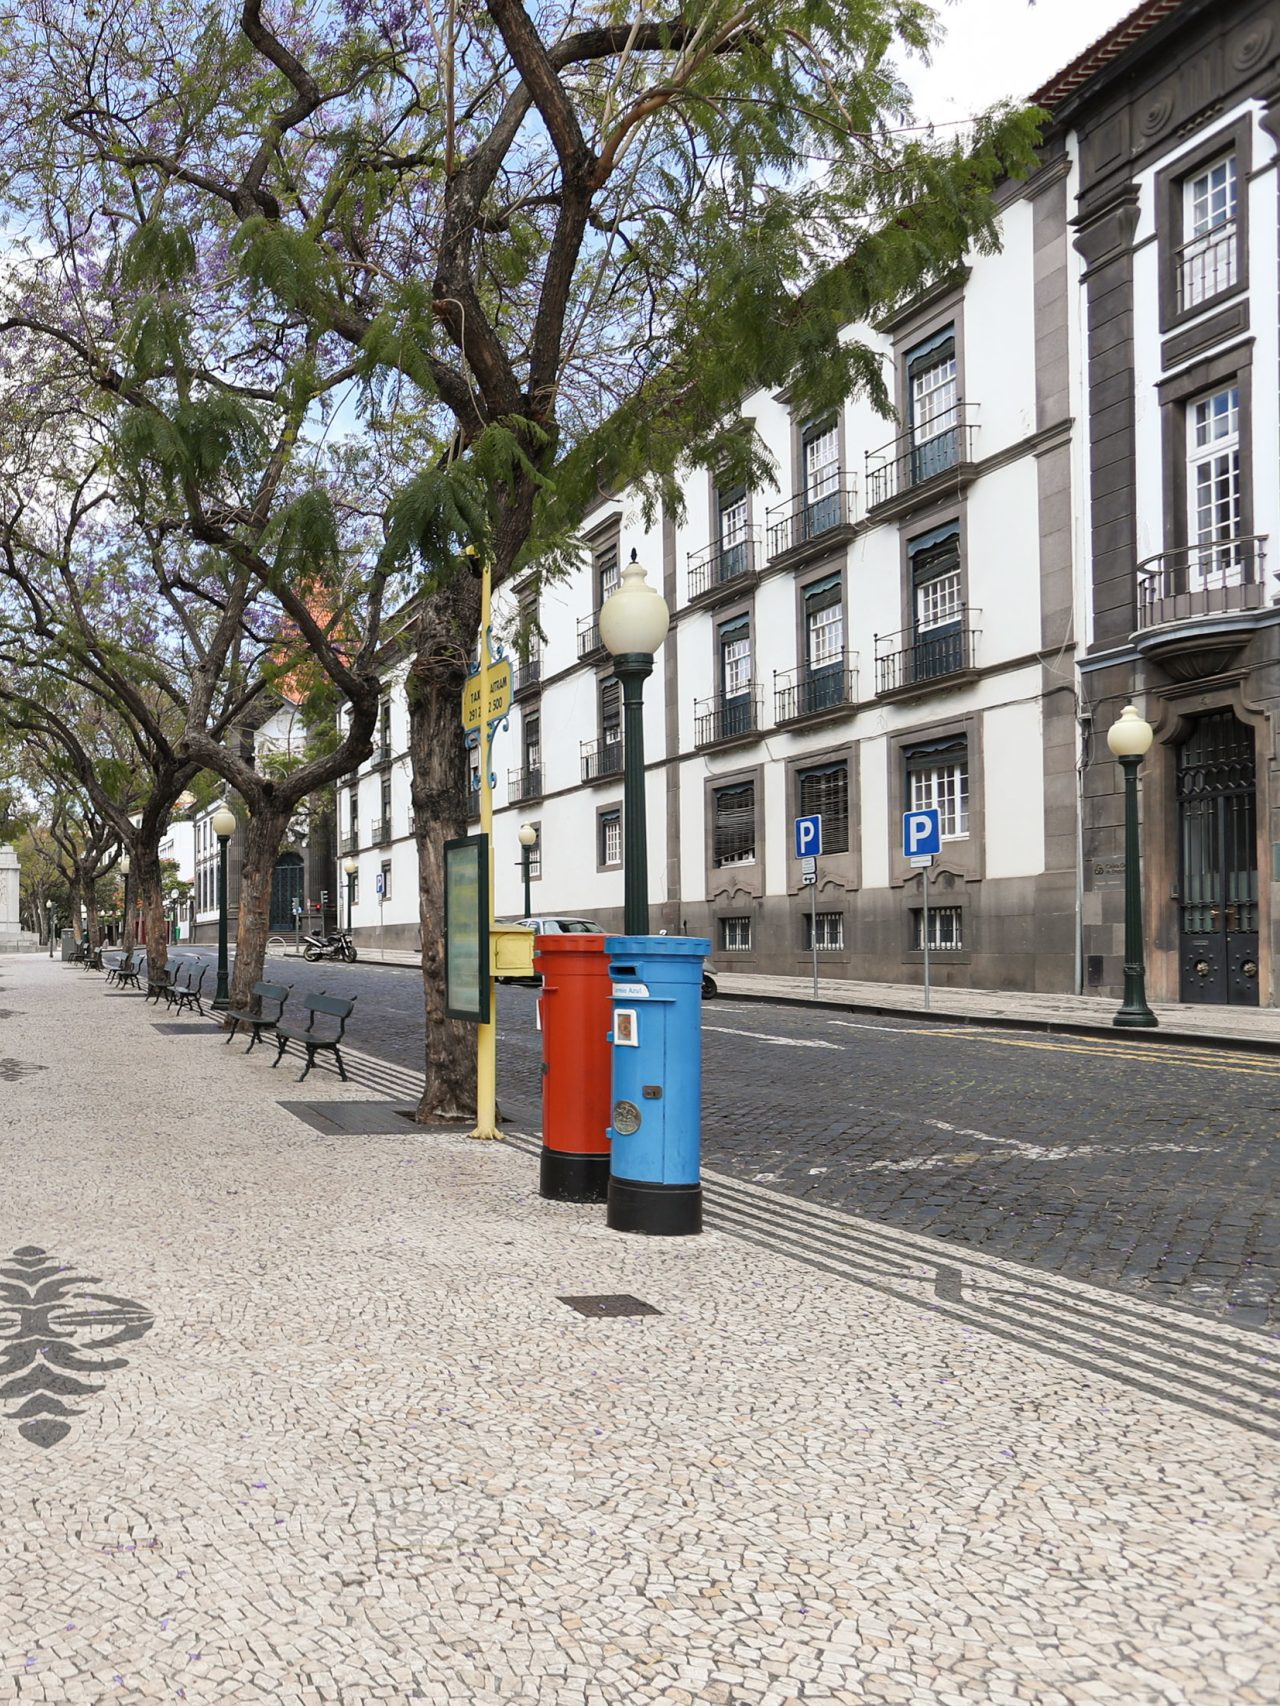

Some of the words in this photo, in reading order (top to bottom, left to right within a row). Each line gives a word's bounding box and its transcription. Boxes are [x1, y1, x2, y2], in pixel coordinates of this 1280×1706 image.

[490, 676, 507, 693] AITRAM
[469, 708, 477, 722] 291
[492, 697, 503, 711] 500
[800, 821, 815, 854] P
[909, 815, 933, 853] P
